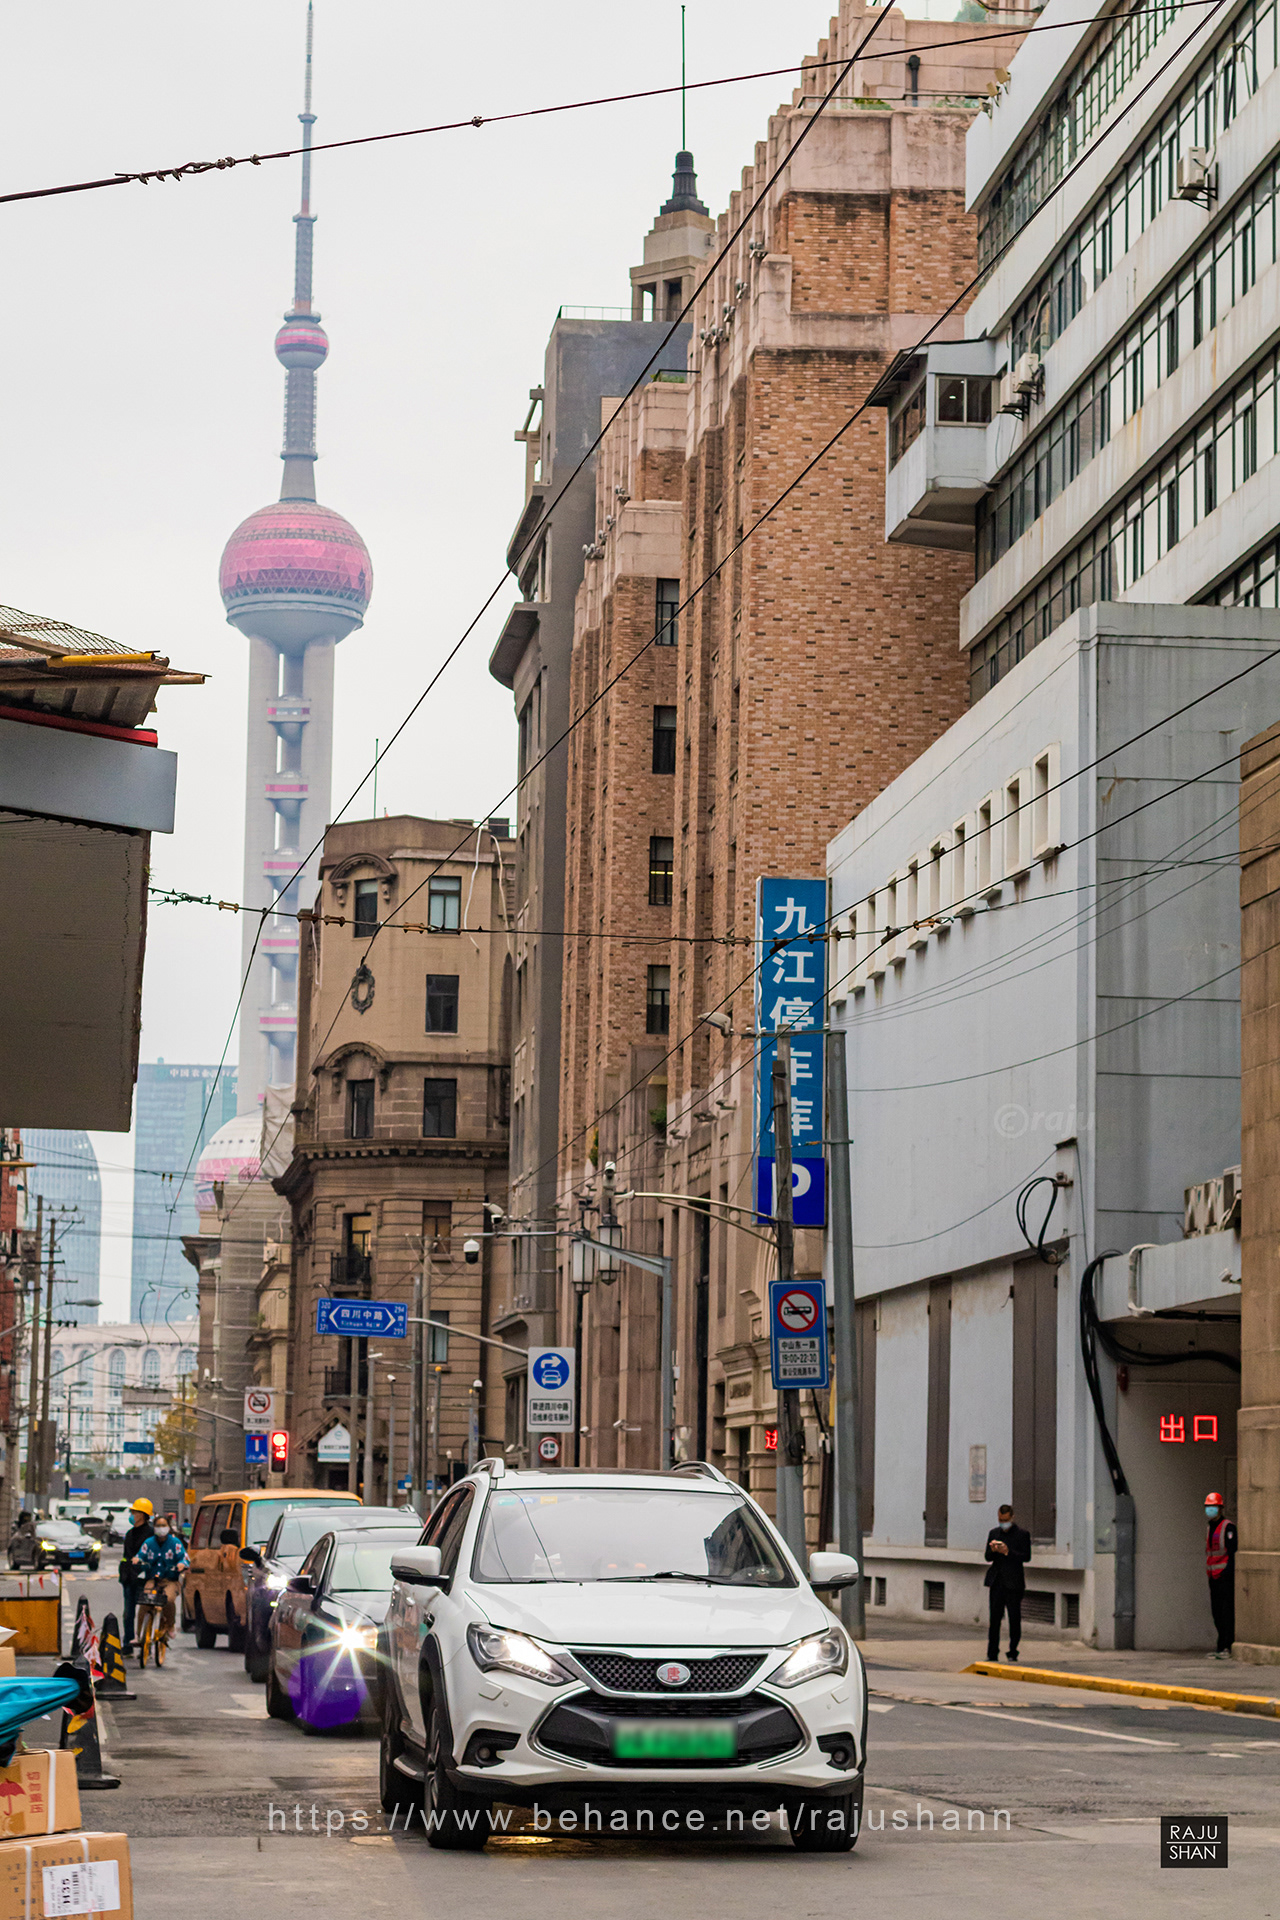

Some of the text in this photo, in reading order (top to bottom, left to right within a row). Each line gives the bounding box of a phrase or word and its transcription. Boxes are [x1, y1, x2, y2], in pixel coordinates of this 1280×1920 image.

[341, 1309, 383, 1321] 四川中路
[782, 1340, 816, 1350] 中山东一路
[782, 1353, 817, 1363] 19:00-22:30
[1160, 1413, 1218, 1443] 出口
